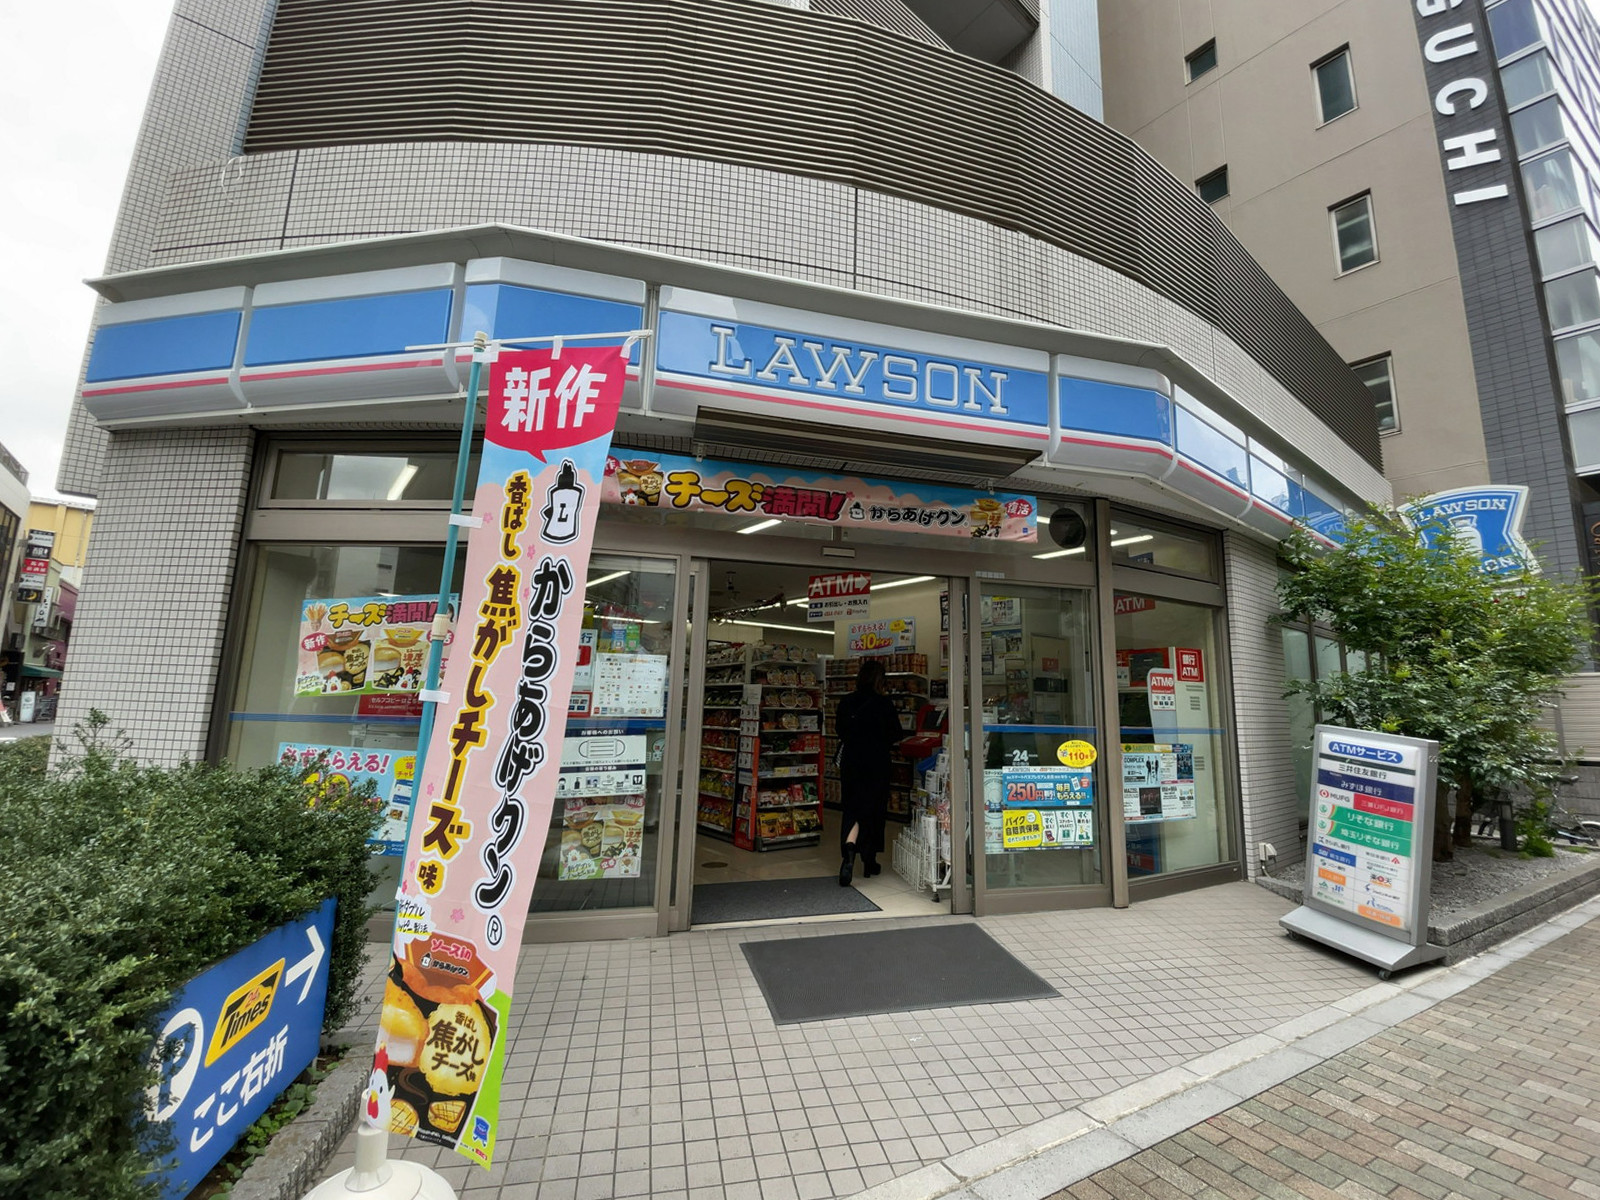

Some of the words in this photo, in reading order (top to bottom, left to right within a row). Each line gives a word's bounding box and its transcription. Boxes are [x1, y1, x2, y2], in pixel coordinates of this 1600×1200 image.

[709, 323, 1009, 416] LAWSON
[501, 363, 607, 433] 新作
[869, 505, 966, 527] からあげクン
[1007, 501, 1029, 515] 復活
[1419, 498, 1508, 523] LAWSON
[810, 574, 854, 597] ATM
[1115, 596, 1145, 613] ATM
[303, 635, 326, 650] 新作
[1182, 654, 1196, 665] 銀行
[1182, 667, 1199, 677] ATM
[280, 748, 389, 775] 必ずらえる!
[1012, 749, 1029, 762] 24
[1331, 742, 1398, 763] ATMサービス
[1338, 763, 1388, 780] 三井住友銀行
[1330, 792, 1350, 803] MUFG
[1340, 780, 1383, 796] みずほ銀行
[1005, 815, 1026, 826] バイク
[1347, 811, 1395, 831] りそな銀行
[1340, 827, 1400, 850] 埼玉りそな銀行
[431, 939, 472, 961] ソースin
[219, 970, 279, 1050] Times
[454, 1010, 478, 1034] 香ばし
[426, 1018, 485, 1066] 焦がし
[190, 1024, 290, 1153] ここ右折
